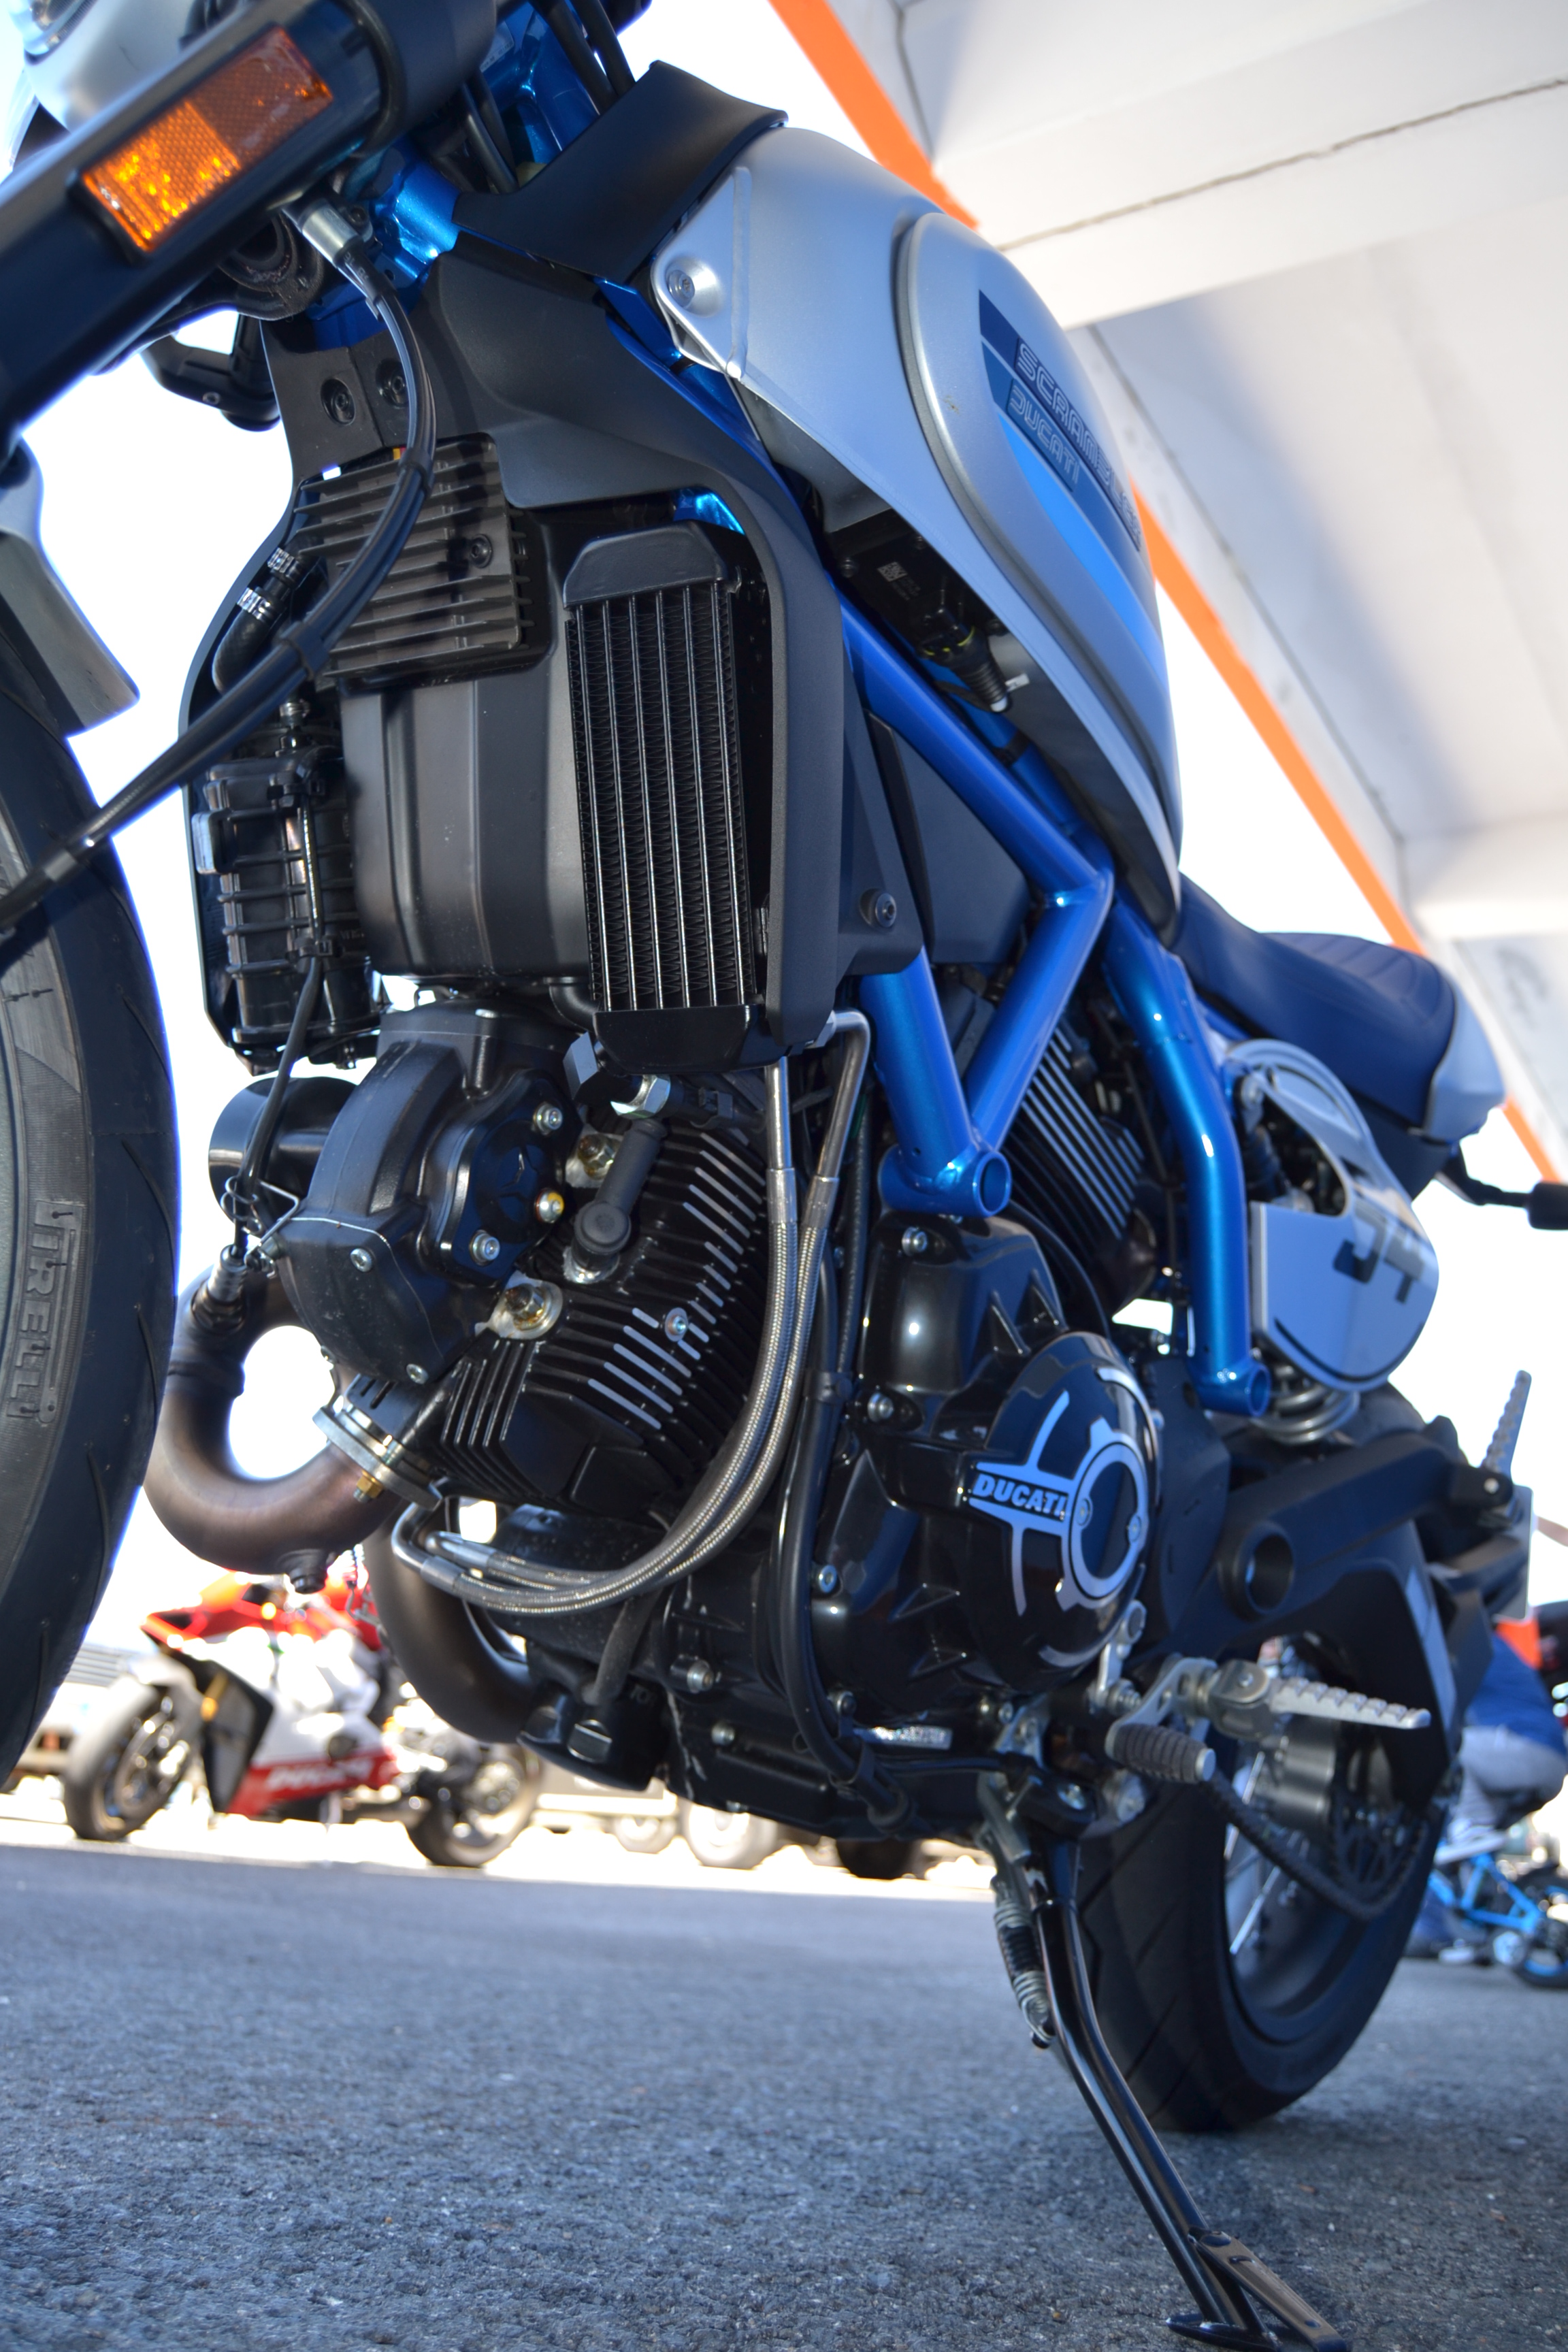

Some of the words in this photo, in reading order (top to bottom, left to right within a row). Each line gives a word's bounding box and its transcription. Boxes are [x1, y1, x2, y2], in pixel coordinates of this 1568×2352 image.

[1009, 388, 1081, 483] DUCATI
[1018, 342, 1141, 546] SCRAMBLER
[7, 1200, 82, 1423] PIRELLI
[973, 1474, 1066, 1517] DUCATI
